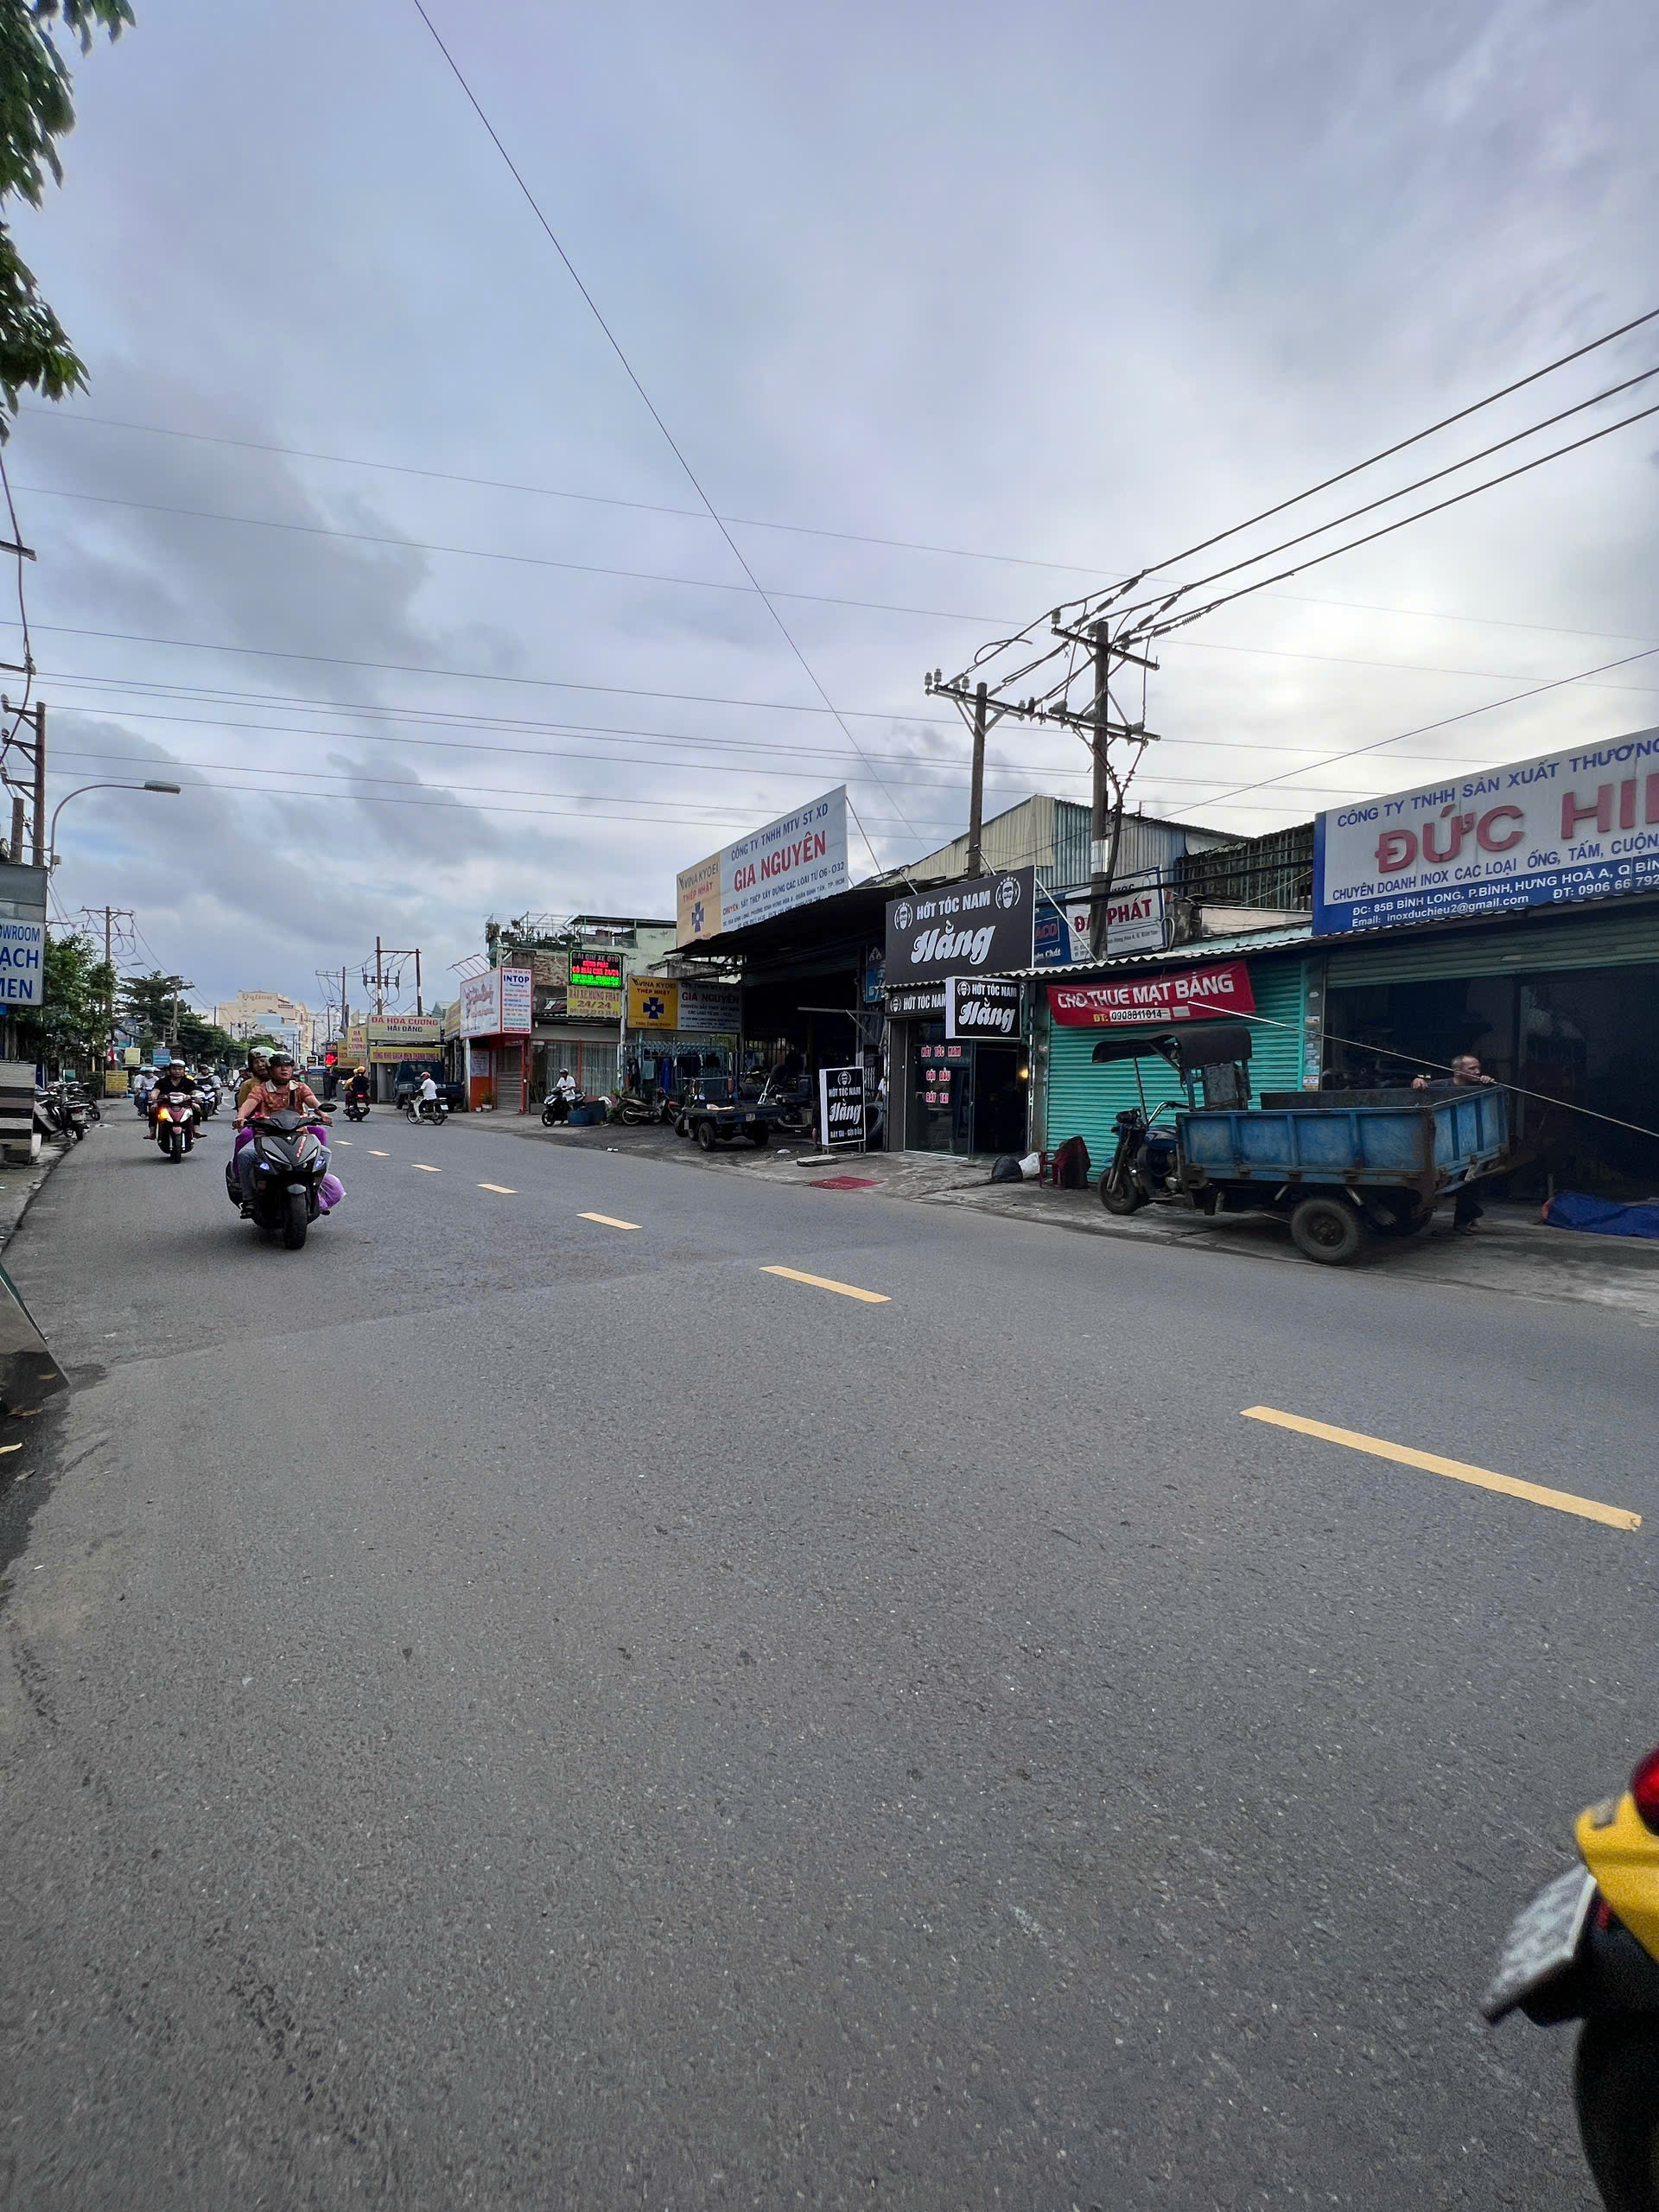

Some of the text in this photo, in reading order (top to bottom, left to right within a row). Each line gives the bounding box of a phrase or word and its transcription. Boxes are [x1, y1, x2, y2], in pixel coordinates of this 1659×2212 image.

[1337, 807, 1379, 827] CÔNG
[1384, 800, 1404, 817] TY
[1411, 788, 1455, 810] TNHH
[1462, 776, 1500, 798] SẢN
[1507, 760, 1560, 787] XUẤT
[750, 837, 759, 852] TY
[761, 827, 781, 846] TNHH
[783, 817, 800, 836] MTV
[803, 810, 813, 826] ST
[817, 803, 828, 819] XD
[1374, 804, 1525, 874] ĐỨC
[698, 862, 718, 881] KYOEI
[734, 830, 826, 892] GIA NGUYÊN
[1332, 882, 1374, 901] CHUYÊN
[1377, 876, 1416, 894] DOANH
[1421, 870, 1449, 887] INOX
[1485, 858, 1516, 875] LOẠI
[1527, 849, 1560, 868] ỐNG,
[1568, 840, 1604, 861] TẤM,
[916, 890, 991, 920] HỚT TÓC NAM
[1351, 915, 1382, 927] Email:
[1387, 894, 1529, 922] inoxduchieu2@gmail.com
[1553, 887, 1574, 899] ĐT:
[1578, 881, 1610, 895] 0906
[1614, 879, 1631, 890] 66
[1352, 906, 1371, 916] ĐC:
[1374, 902, 1394, 912] 85B
[1396, 896, 1424, 910] BÌNH
[1427, 891, 1465, 905] LONG,
[1515, 876, 1557, 892] HƯNG
[1561, 868, 1595, 884] HOÀ
[1599, 868, 1613, 880] A,
[1107, 893, 1152, 925] PHÁT
[0, 924, 40, 943] WROOM
[911, 919, 995, 965] Hằng
[504, 975, 530, 983] INTOP
[987, 983, 999, 996] TÓC
[1001, 986, 1017, 997] NAM
[576, 1000, 612, 1009] 24/24
[682, 992, 698, 1001] GIA
[917, 993, 930, 1009] TÓC
[1058, 992, 1088, 1008] CHO
[958, 997, 1015, 1033] Hằng
[1093, 1013, 1109, 1023] ĐT:
[934, 1045, 944, 1058] TÓC
[839, 1086, 848, 1096] TÓC
[849, 1086, 861, 1096] NAM
[829, 1098, 861, 1125] Hằng
